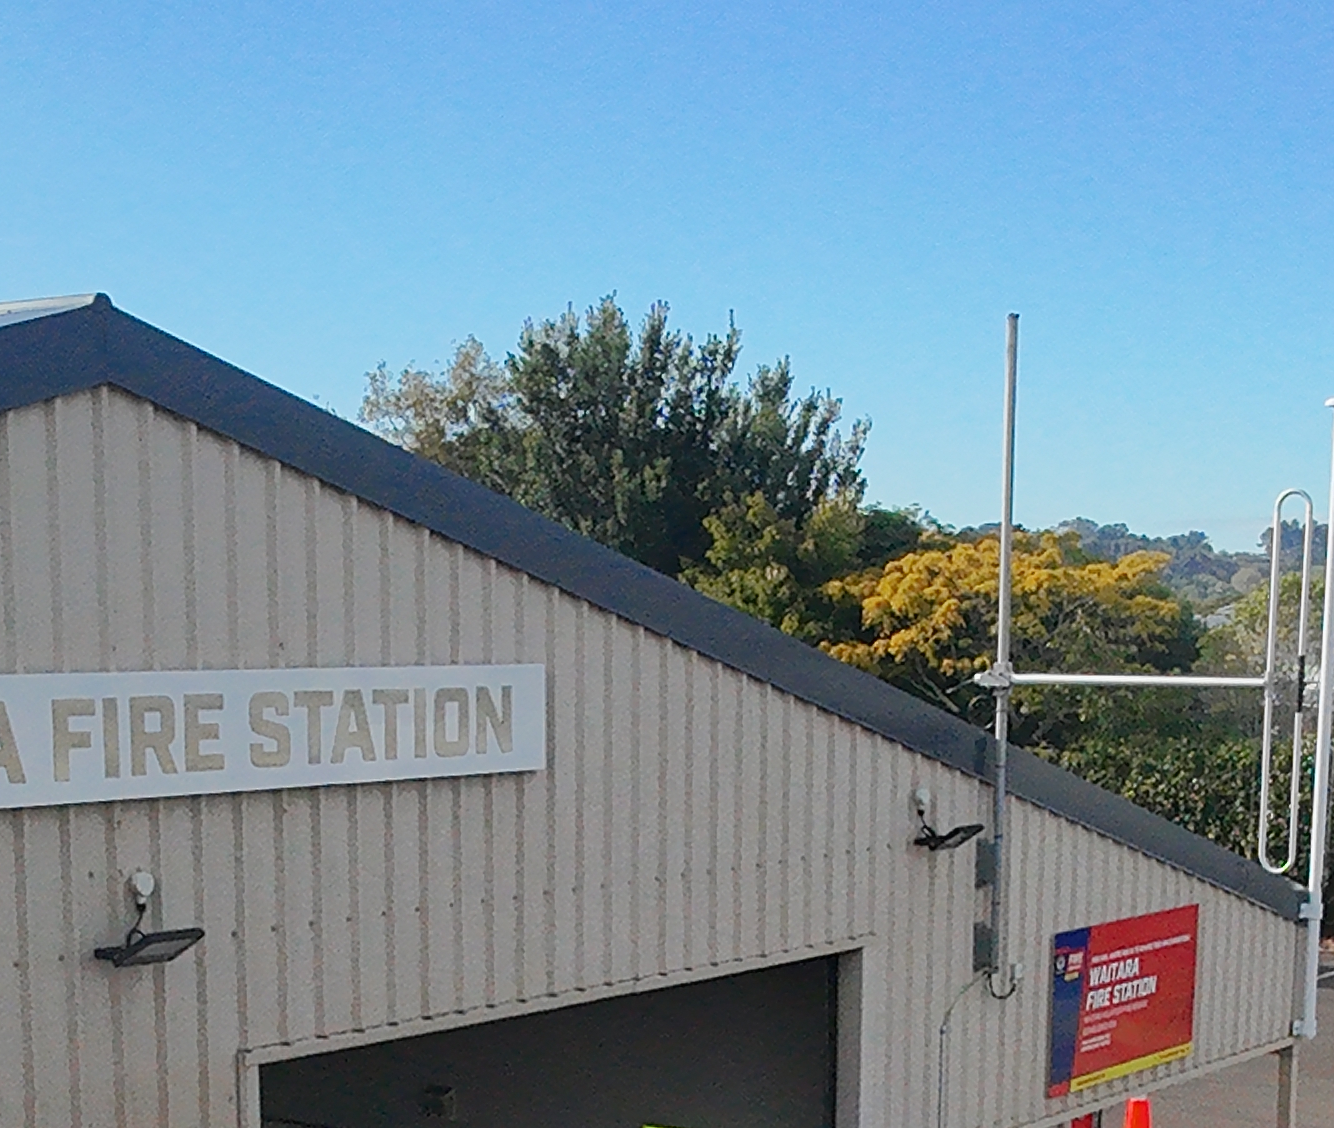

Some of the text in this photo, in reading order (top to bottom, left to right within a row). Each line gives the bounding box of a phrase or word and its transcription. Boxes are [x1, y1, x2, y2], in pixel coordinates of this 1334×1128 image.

[49, 693, 225, 783] FIRE
[247, 684, 513, 768] STATION
[1088, 957, 1140, 987] WAITARA
[1086, 975, 1158, 1011] FIRE STATION
